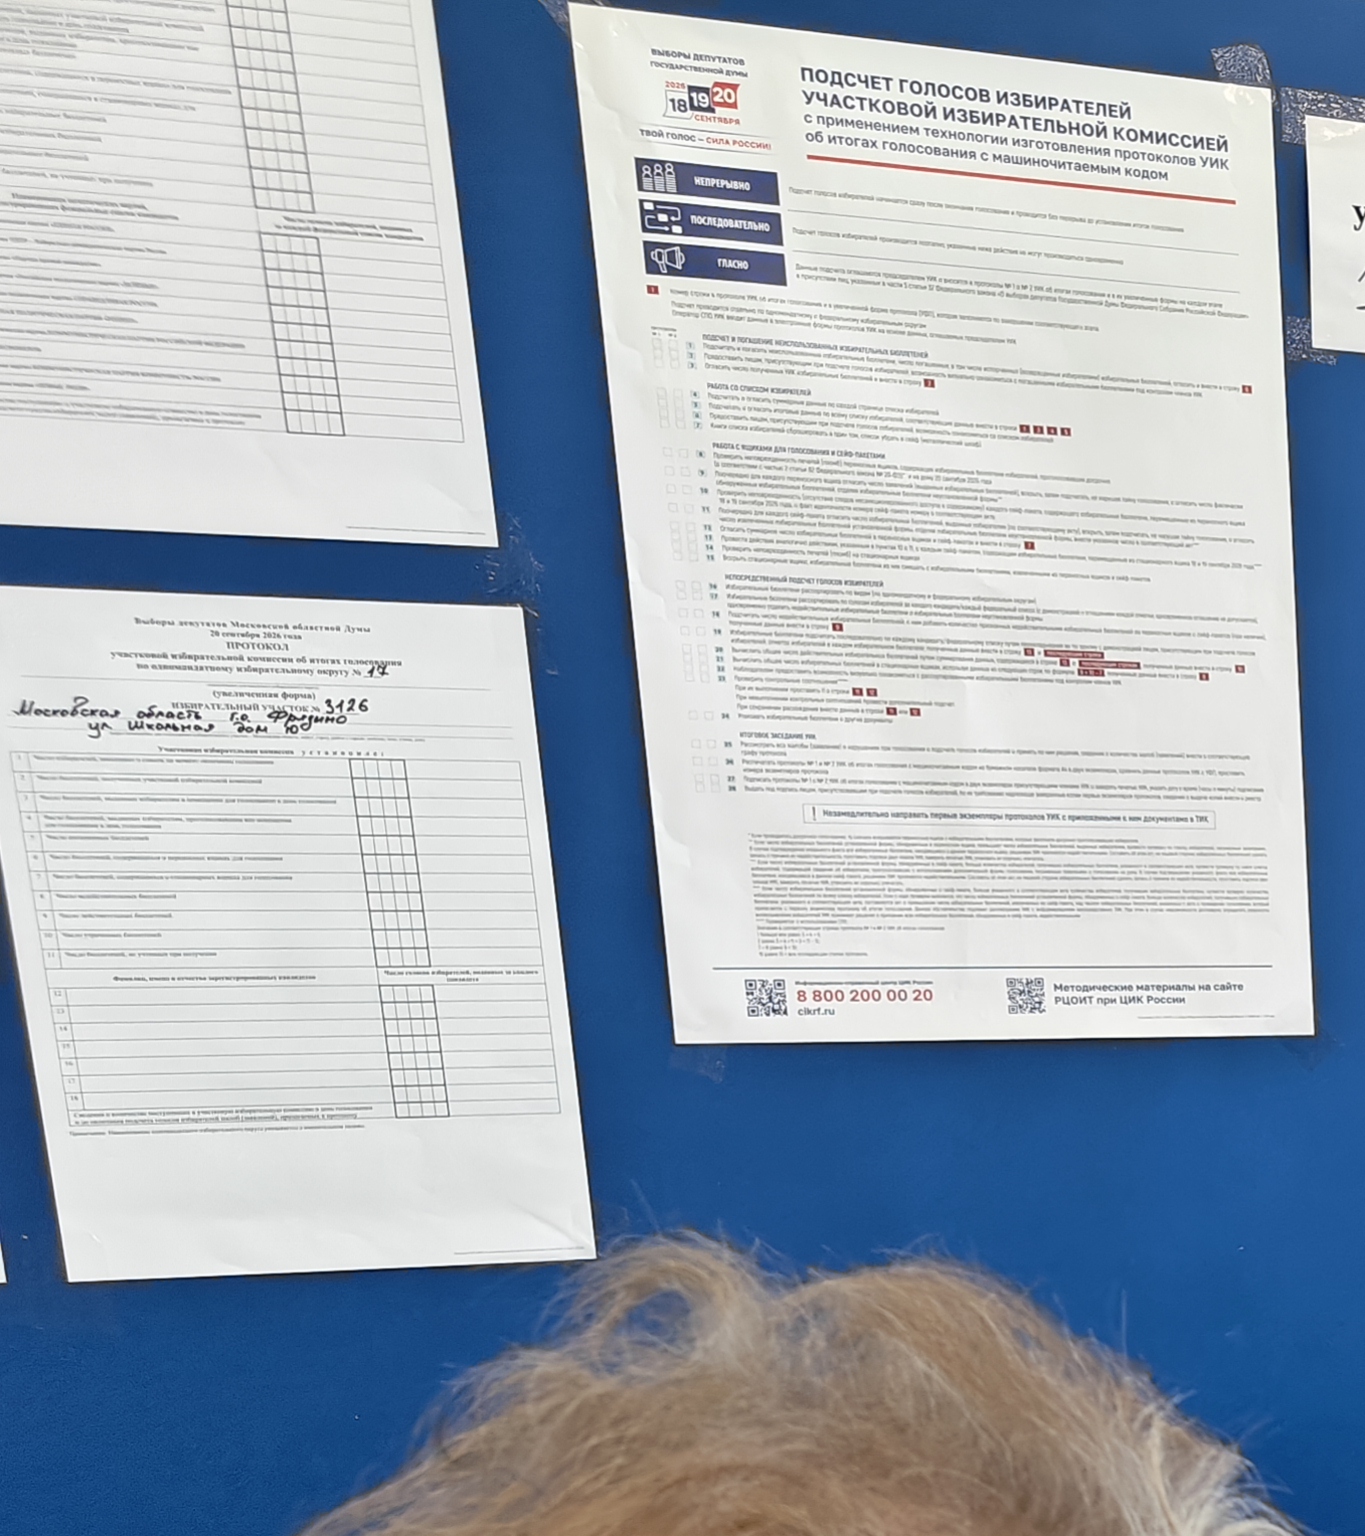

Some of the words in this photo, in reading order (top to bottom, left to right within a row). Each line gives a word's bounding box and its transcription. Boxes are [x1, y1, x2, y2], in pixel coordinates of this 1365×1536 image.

[651, 49, 691, 59] ВЫБОРЫ
[692, 53, 745, 66] ДЕПУТАТОВ
[664, 81, 686, 89] 2026
[800, 66, 892, 92] ПОДСЧЕТ
[897, 78, 991, 103] ГОЛОСОВ
[995, 89, 1131, 120] ИЗБИРАТЕЛЕЙ
[668, 97, 688, 113] 18
[690, 91, 709, 108] 19
[711, 86, 736, 104] 20
[694, 114, 740, 125] СЕНТЯБРЯ
[802, 89, 938, 120] УЧАСТКОВОЙ
[941, 103, 1108, 139] ИЗБИРАТЕЛЬНОЙ
[1112, 123, 1228, 153] КОМИССИЕЙ
[639, 129, 664, 139] ТВОЙ
[666, 131, 696, 142] ГОЛОС
[705, 136, 729, 146] СИЛА
[816, 115, 920, 136] применением
[924, 127, 1008, 146] технологии
[1011, 136, 1111, 157] изготовления
[1114, 148, 1196, 166] протоколов
[1199, 155, 1232, 171] УИК
[802, 128, 824, 146] об
[827, 134, 878, 149] итогах
[881, 140, 977, 160] голосования
[991, 149, 1121, 176] машиночитаемым
[1124, 163, 1171, 181] кодом
[694, 176, 750, 191] НЕПРЕРЫВНО
[690, 214, 770, 232] ПОСЛЕДОВАТЕЛЬНО
[717, 258, 749, 270] ГЛАСНО
[225, 641, 289, 651] ПРОТОКОЛ
[12, 696, 121, 720] Московская
[137, 708, 202, 721] область
[323, 698, 370, 715] 3126
[796, 989, 807, 1002] 8
[811, 989, 845, 1002] 800
[849, 988, 882, 1002] 200
[885, 988, 908, 1001] 00
[912, 988, 936, 1001] 20
[1053, 984, 1133, 992] Методические
[1135, 983, 1195, 991] материалы
[1198, 983, 1211, 991] на
[1213, 983, 1246, 991] сайте
[1054, 995, 1093, 1005] РЦОИТ
[1119, 995, 1143, 1004] ЦИК
[1146, 995, 1188, 1004] России
[797, 1007, 838, 1016] cikrf.ru
